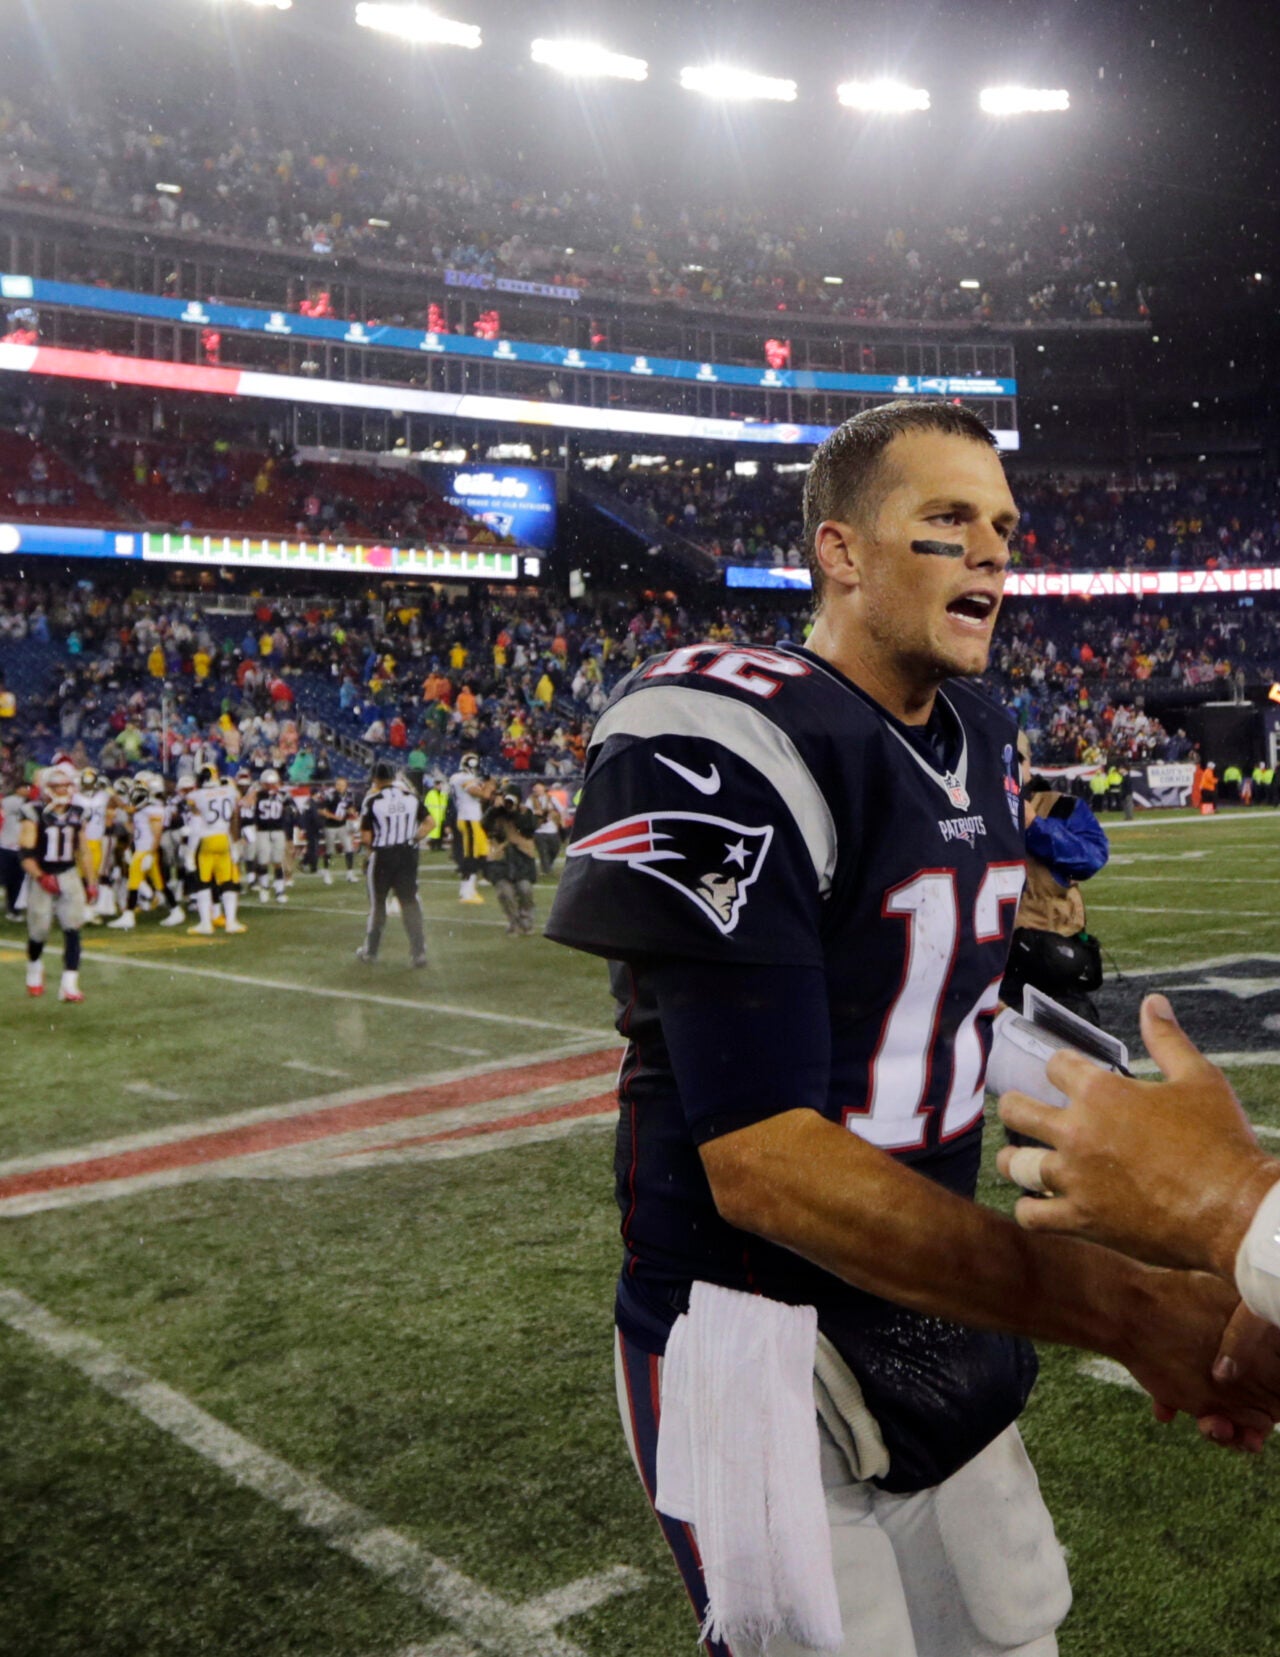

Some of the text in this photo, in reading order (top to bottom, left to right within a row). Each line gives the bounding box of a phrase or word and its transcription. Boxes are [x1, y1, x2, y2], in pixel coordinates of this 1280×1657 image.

[642, 642, 813, 699] 12
[259, 800, 283, 820] 50
[938, 815, 987, 842] PATRIOTS
[44, 825, 74, 863] 11
[841, 860, 1028, 1154] 12
